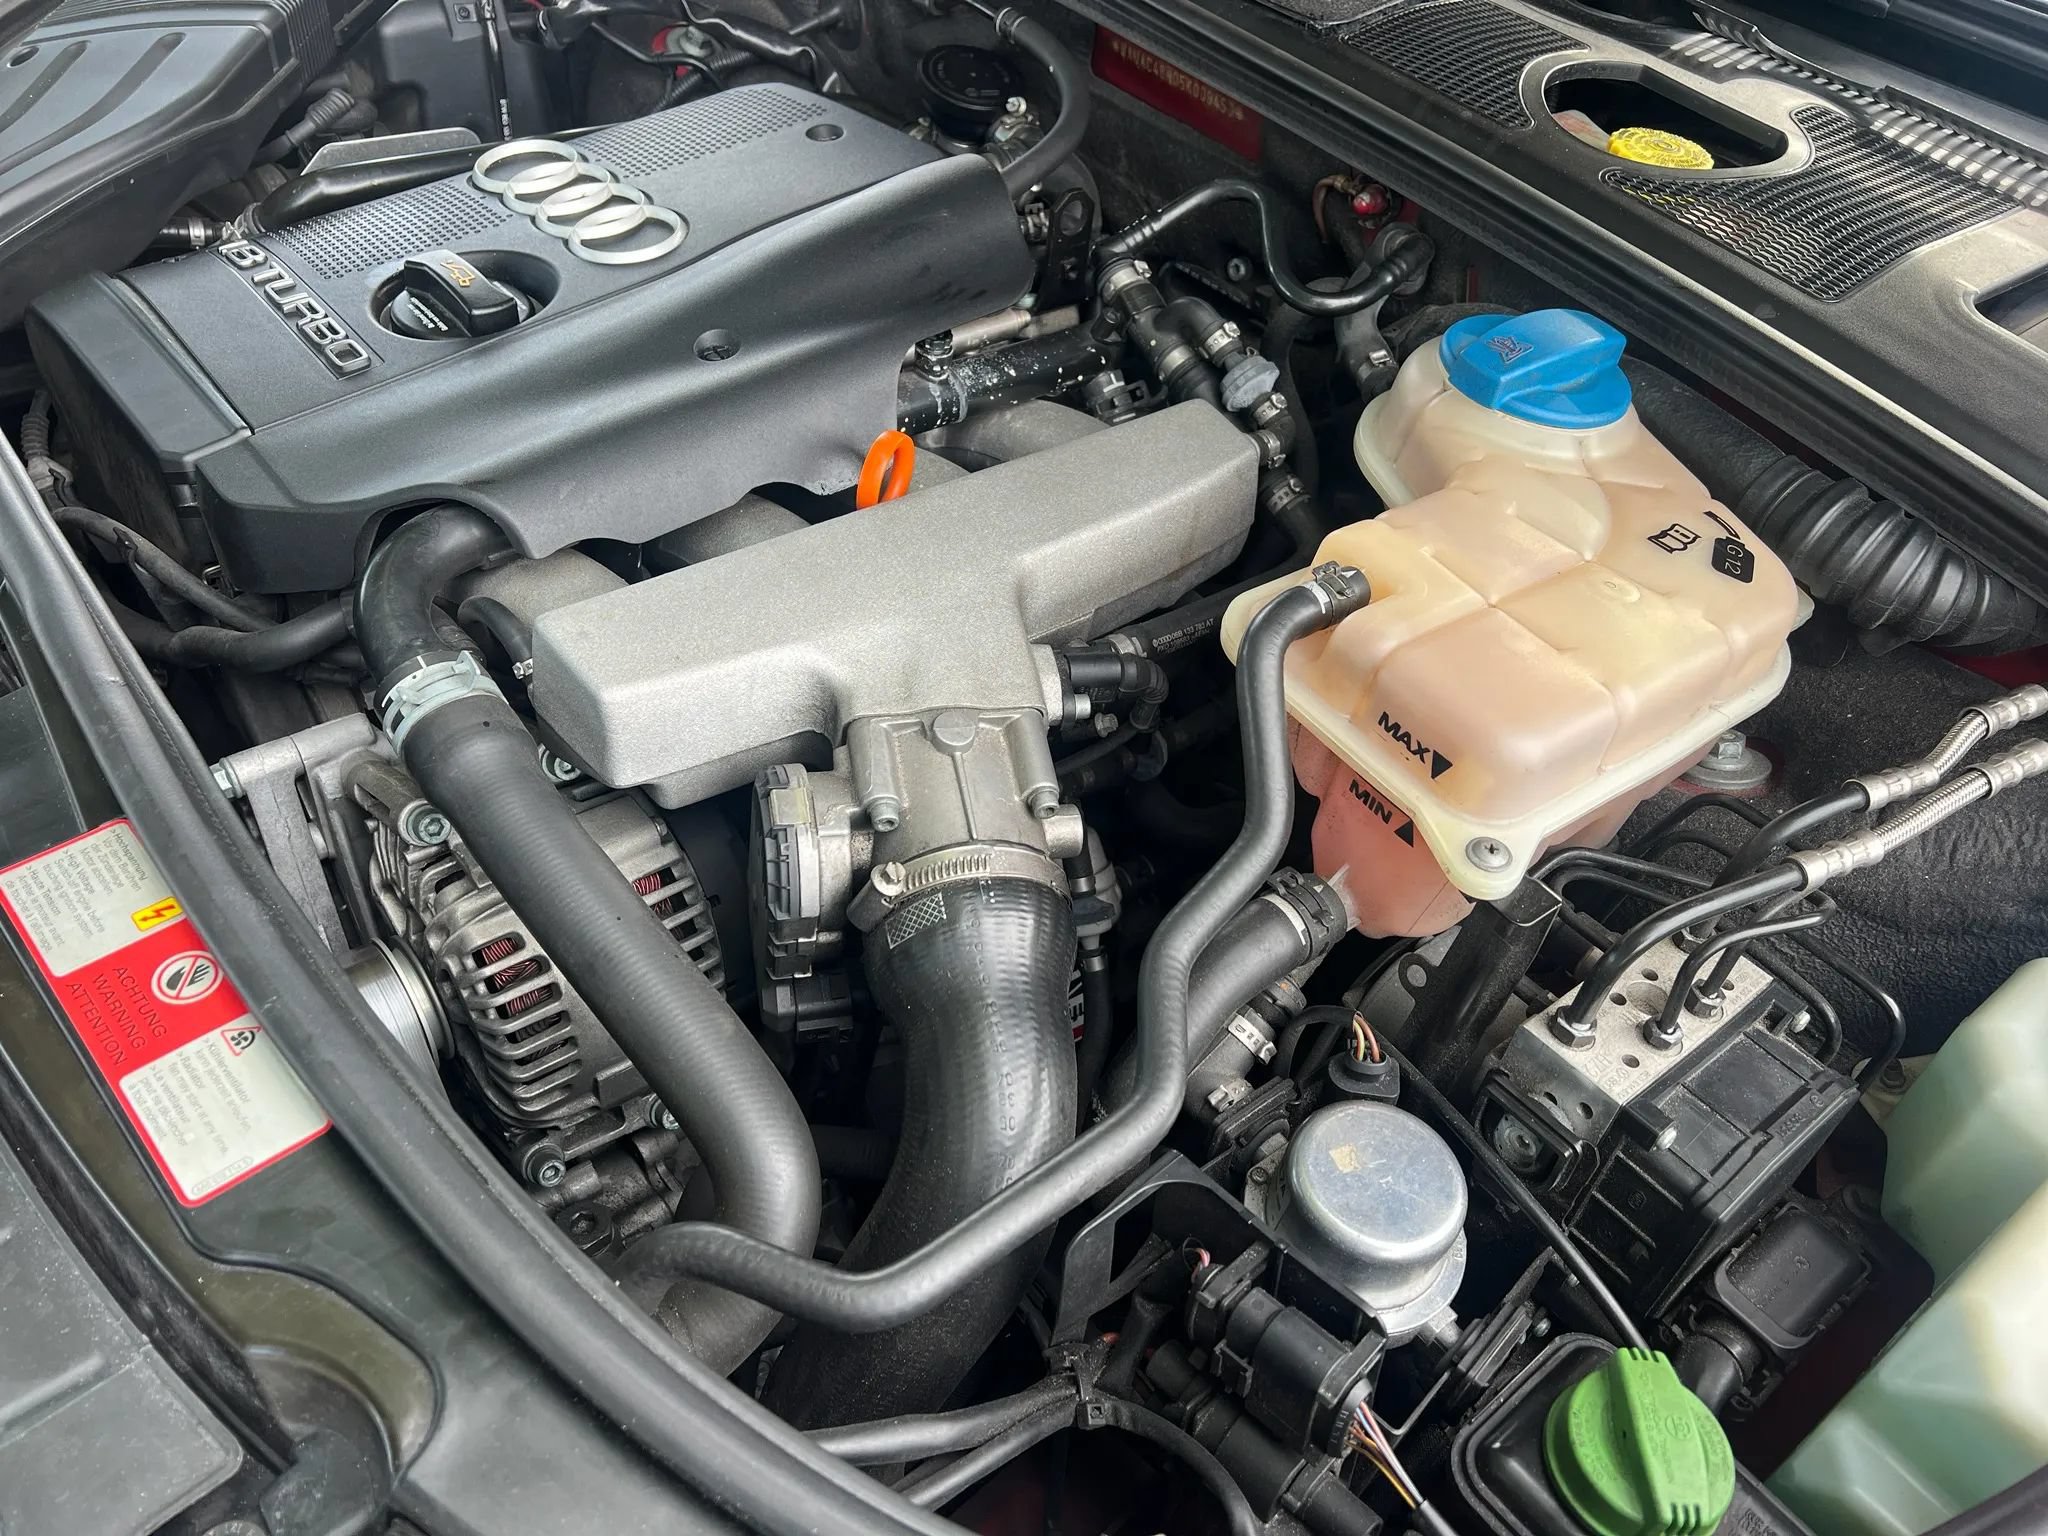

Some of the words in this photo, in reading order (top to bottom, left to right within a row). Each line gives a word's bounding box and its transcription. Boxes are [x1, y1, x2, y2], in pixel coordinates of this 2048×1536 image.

[252, 262, 371, 373] TURBO
[1724, 544, 1744, 575] G12
[1378, 711, 1430, 764] MAX
[1349, 779, 1392, 824] MIN
[65, 981, 128, 1065] ATTENTION
[91, 973, 146, 1049] WARNING
[113, 966, 168, 1038] ACHTUNG
